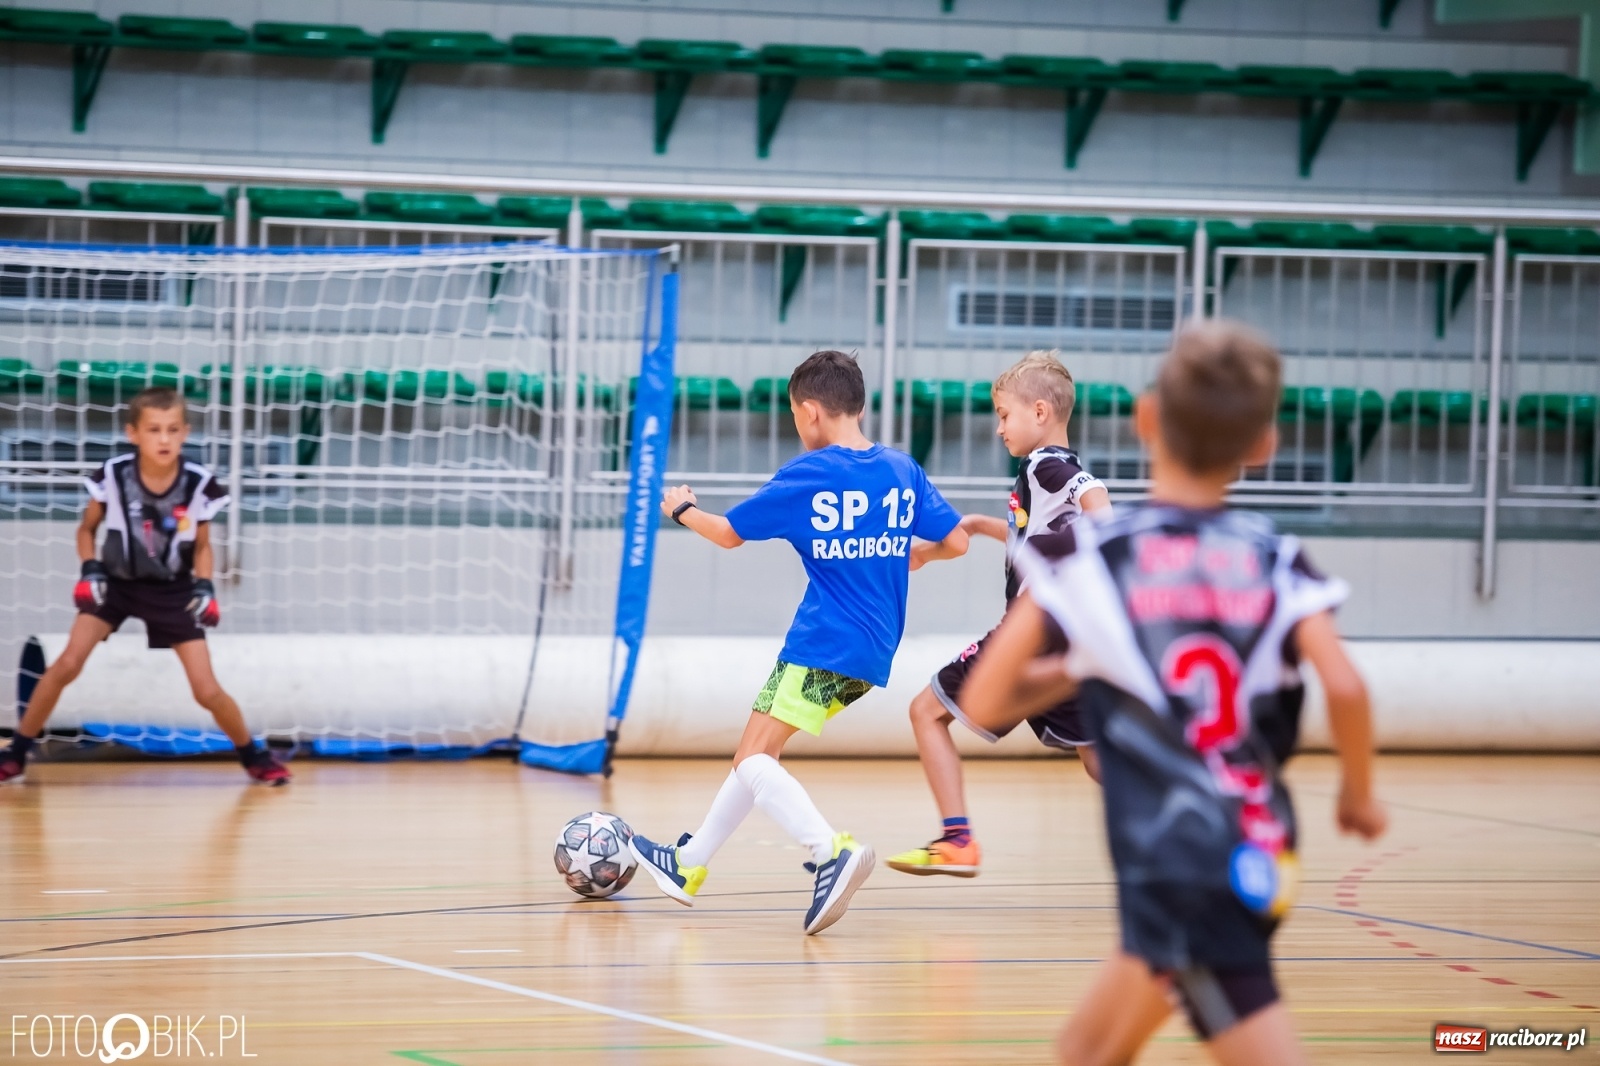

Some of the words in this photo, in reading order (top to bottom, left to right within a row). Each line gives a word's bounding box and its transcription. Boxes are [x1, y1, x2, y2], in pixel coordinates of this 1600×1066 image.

[810, 490, 869, 532] SP
[882, 487, 916, 529] 13
[812, 531, 909, 560] RACIBÓRZ
